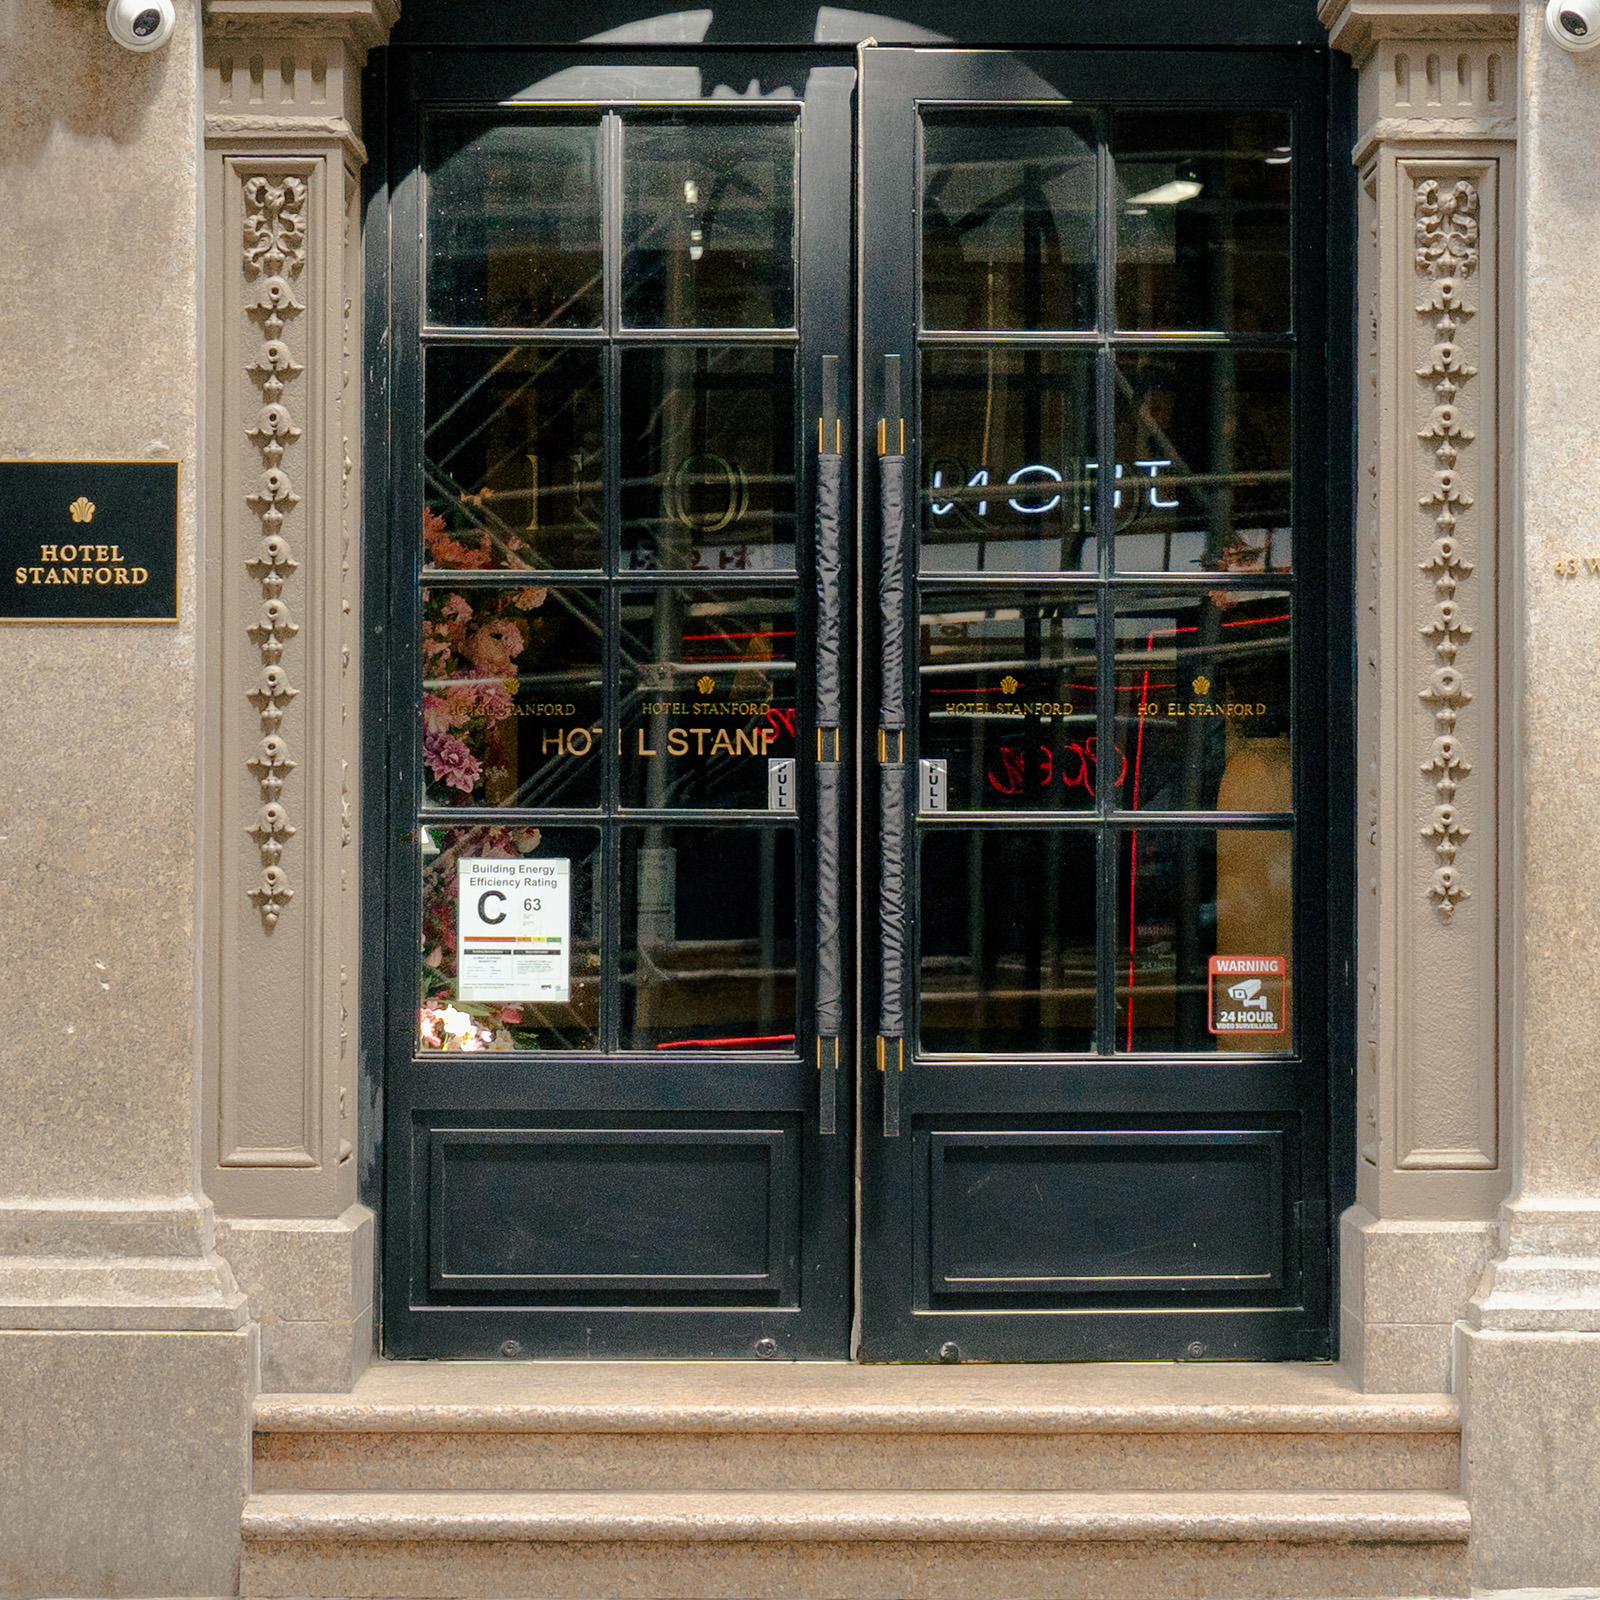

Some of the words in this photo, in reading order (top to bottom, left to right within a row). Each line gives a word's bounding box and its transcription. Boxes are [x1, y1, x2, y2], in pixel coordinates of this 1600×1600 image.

[40, 544, 125, 562] HOTEL
[1553, 557, 1579, 575] 43
[15, 567, 149, 585] STANFORD
[642, 703, 690, 716] HOTEL
[693, 703, 771, 716] STANFORD
[946, 703, 992, 716] HOTEL
[996, 703, 1073, 716] STANFORD
[1138, 703, 1186, 716] HOEL
[1188, 703, 1267, 716] STANFORD
[776, 760, 788, 808] PULL
[928, 762, 939, 809] PULL
[472, 864, 515, 875] Building
[519, 865, 555, 875] Energy
[470, 877, 521, 888] Efficiency
[524, 878, 558, 889] Rating
[477, 890, 507, 925] C
[523, 898, 542, 911] 63
[1216, 960, 1279, 972] WARNING
[1220, 1011, 1236, 1023] 24
[1237, 1011, 1274, 1023] HOUR
